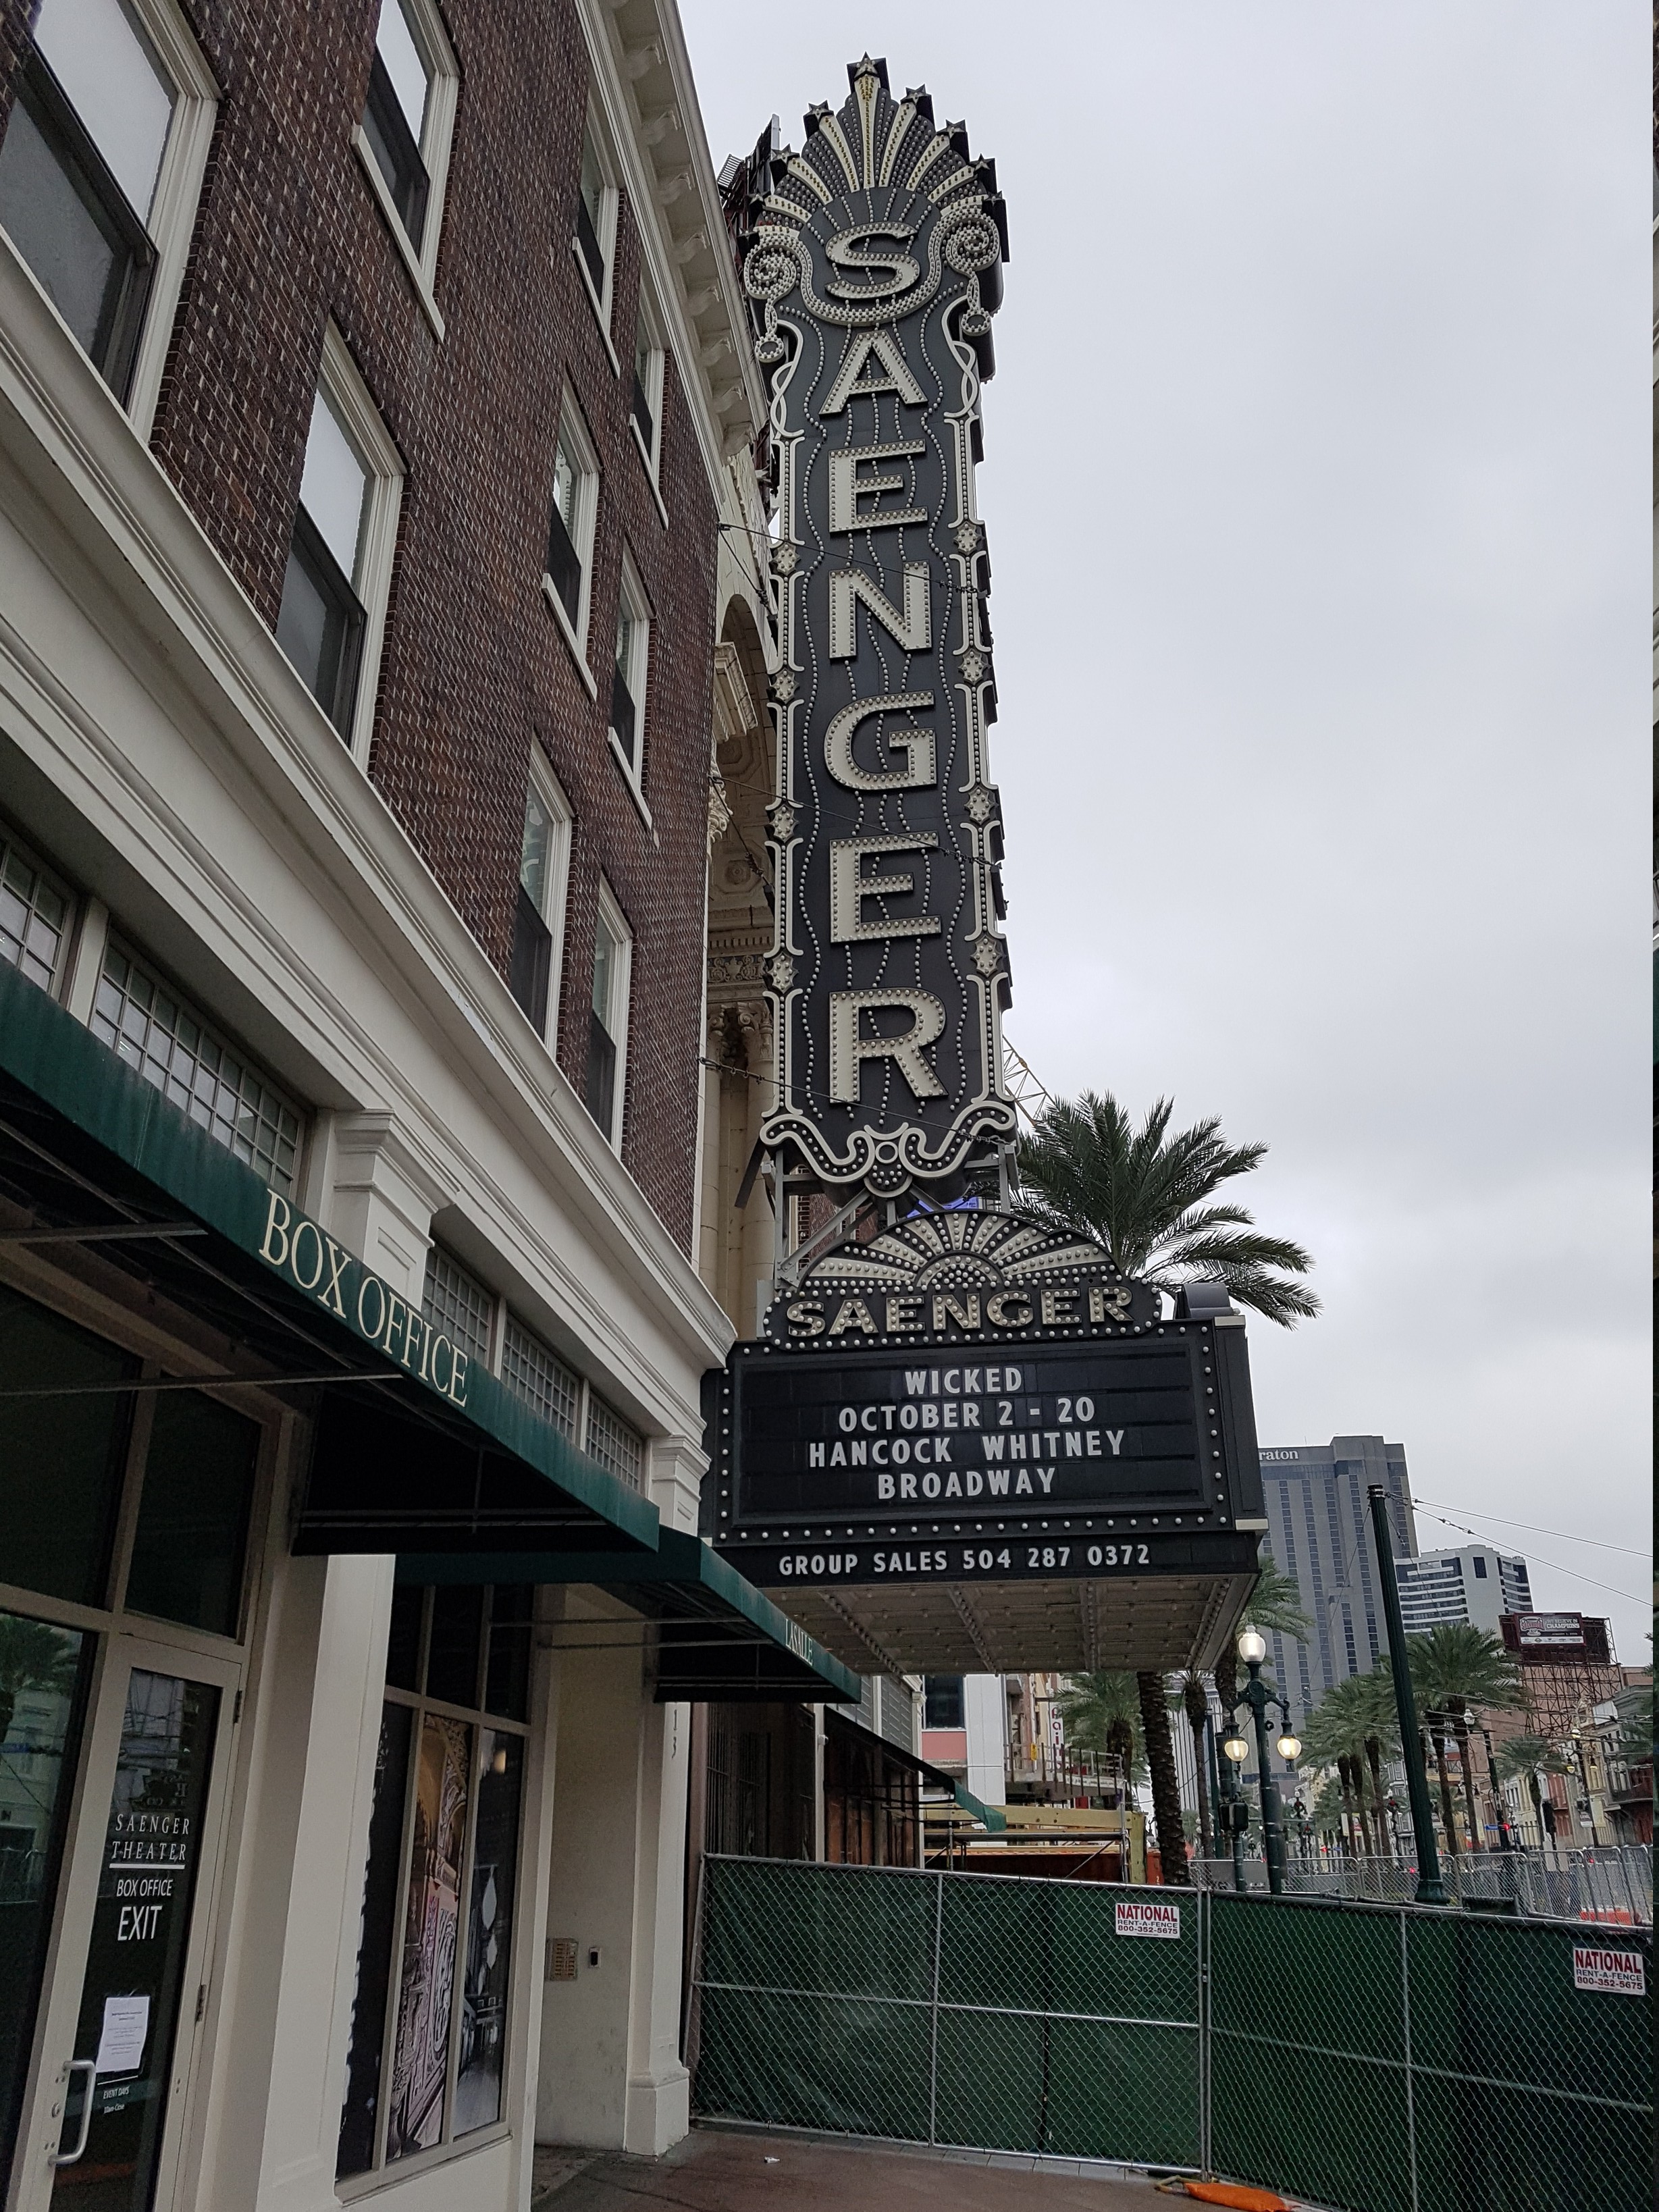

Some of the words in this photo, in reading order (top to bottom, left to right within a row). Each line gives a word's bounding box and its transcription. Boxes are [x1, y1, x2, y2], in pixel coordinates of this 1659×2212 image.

[819, 221, 948, 1103] SAENGER
[259, 1188, 352, 1319] BOX
[358, 1276, 468, 1408] OFFICE
[787, 1286, 1134, 1337] SAENGER
[905, 1367, 1022, 1395] WICKED
[839, 1402, 980, 1432] OCTOBER
[999, 1400, 1013, 1425] 2
[1057, 1396, 1095, 1423] 20
[810, 1437, 952, 1467] HANCOCK
[982, 1430, 1124, 1460] WHITNEY
[878, 1467, 1055, 1499] BROADWAY
[779, 1554, 858, 1575] GROUP
[874, 1550, 947, 1572] SALES
[964, 1549, 1011, 1569] 504
[1028, 1547, 1070, 1567] 287
[1088, 1544, 1149, 1566] 0372
[115, 1814, 190, 1835] SAENGER
[111, 1841, 187, 1860] THEATER
[116, 1879, 138, 1897] BOX
[140, 1879, 174, 1897] OFFICE
[117, 1905, 163, 1941] EXIT
[1117, 1904, 1178, 1922] NATIONAL
[1117, 1919, 1178, 1928] RENT-A-FENCE
[1117, 1925, 1178, 1934] 800-352-5675
[1575, 1949, 1642, 1974] NATIONAL
[1576, 1968, 1643, 1982] RENT-A-FENCE
[1577, 1976, 1643, 1990] 800-352-5675
[103, 2088, 118, 2099] EVENT
